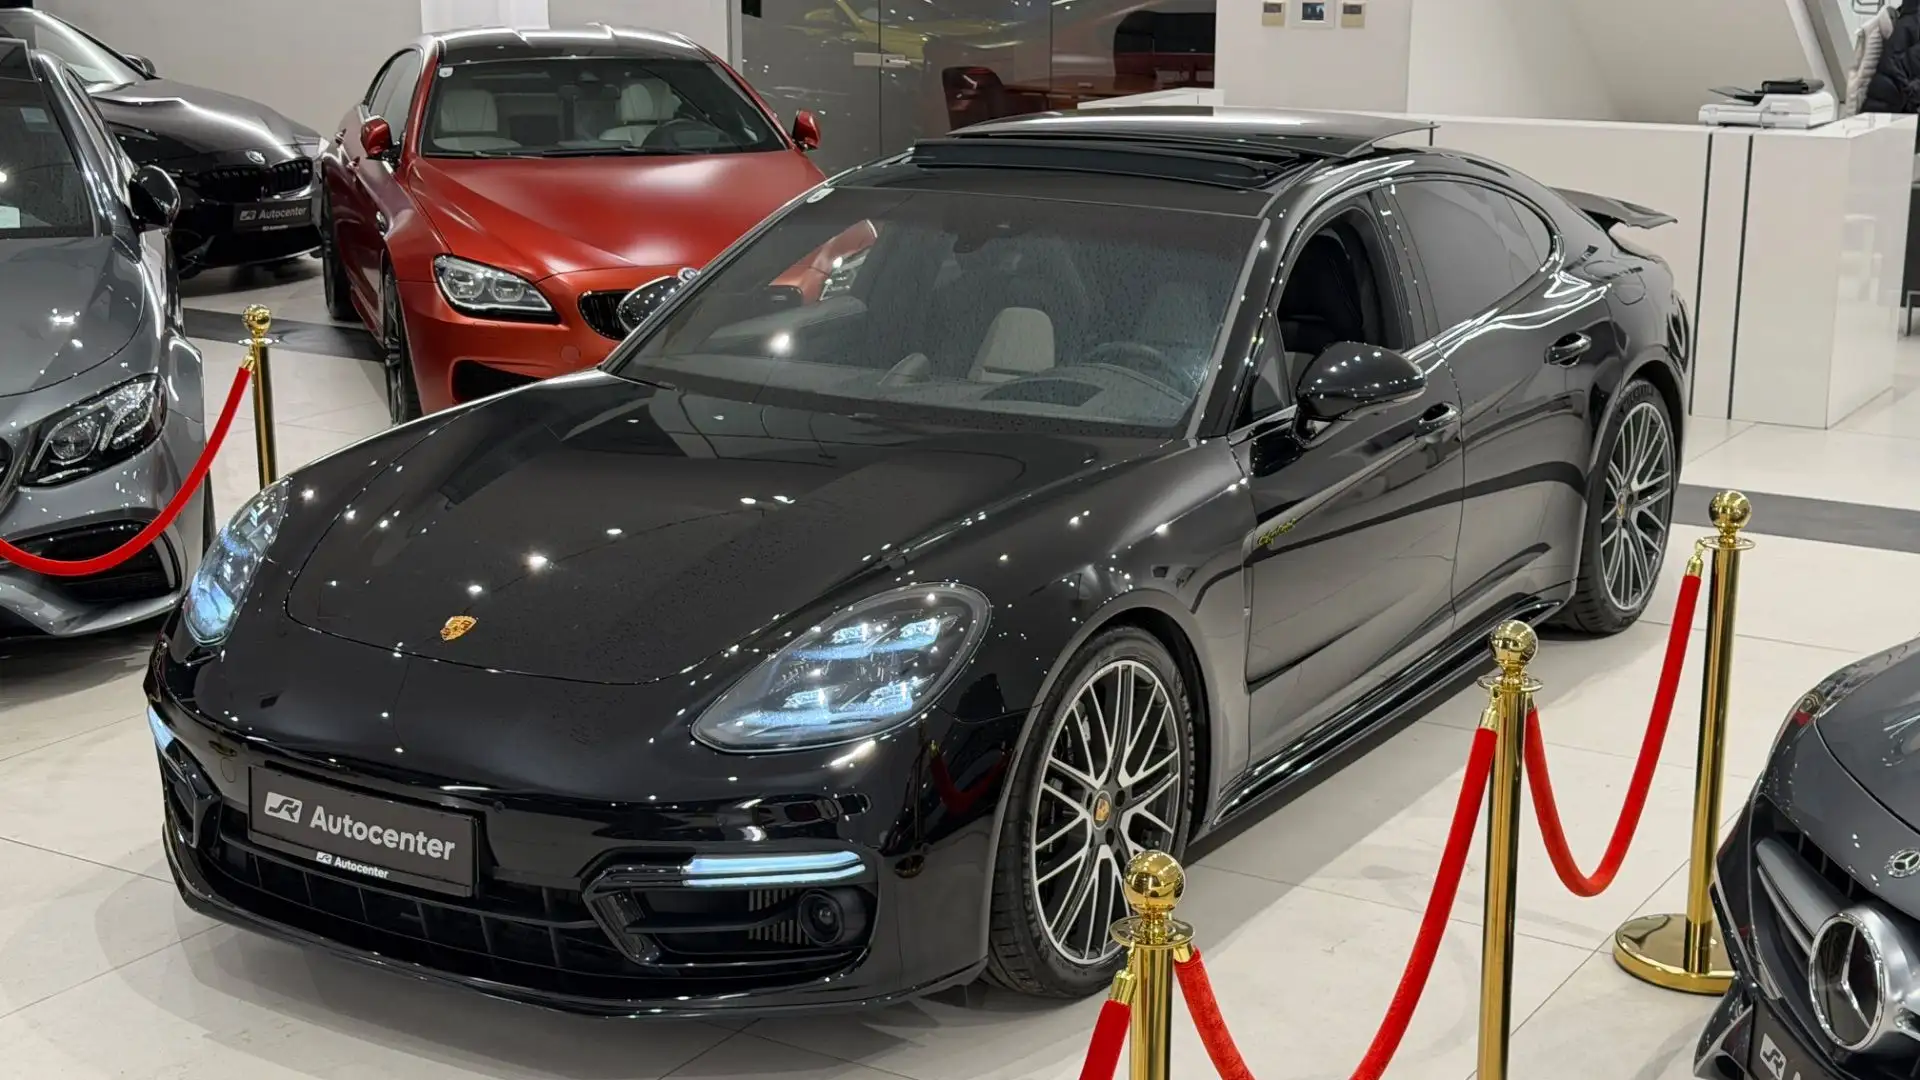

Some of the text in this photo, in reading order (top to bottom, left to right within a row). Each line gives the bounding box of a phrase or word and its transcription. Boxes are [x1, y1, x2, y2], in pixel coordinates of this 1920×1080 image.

[259, 206, 307, 219] Autocenter
[310, 805, 456, 861] Autocenter
[334, 856, 389, 879] Autocenter
